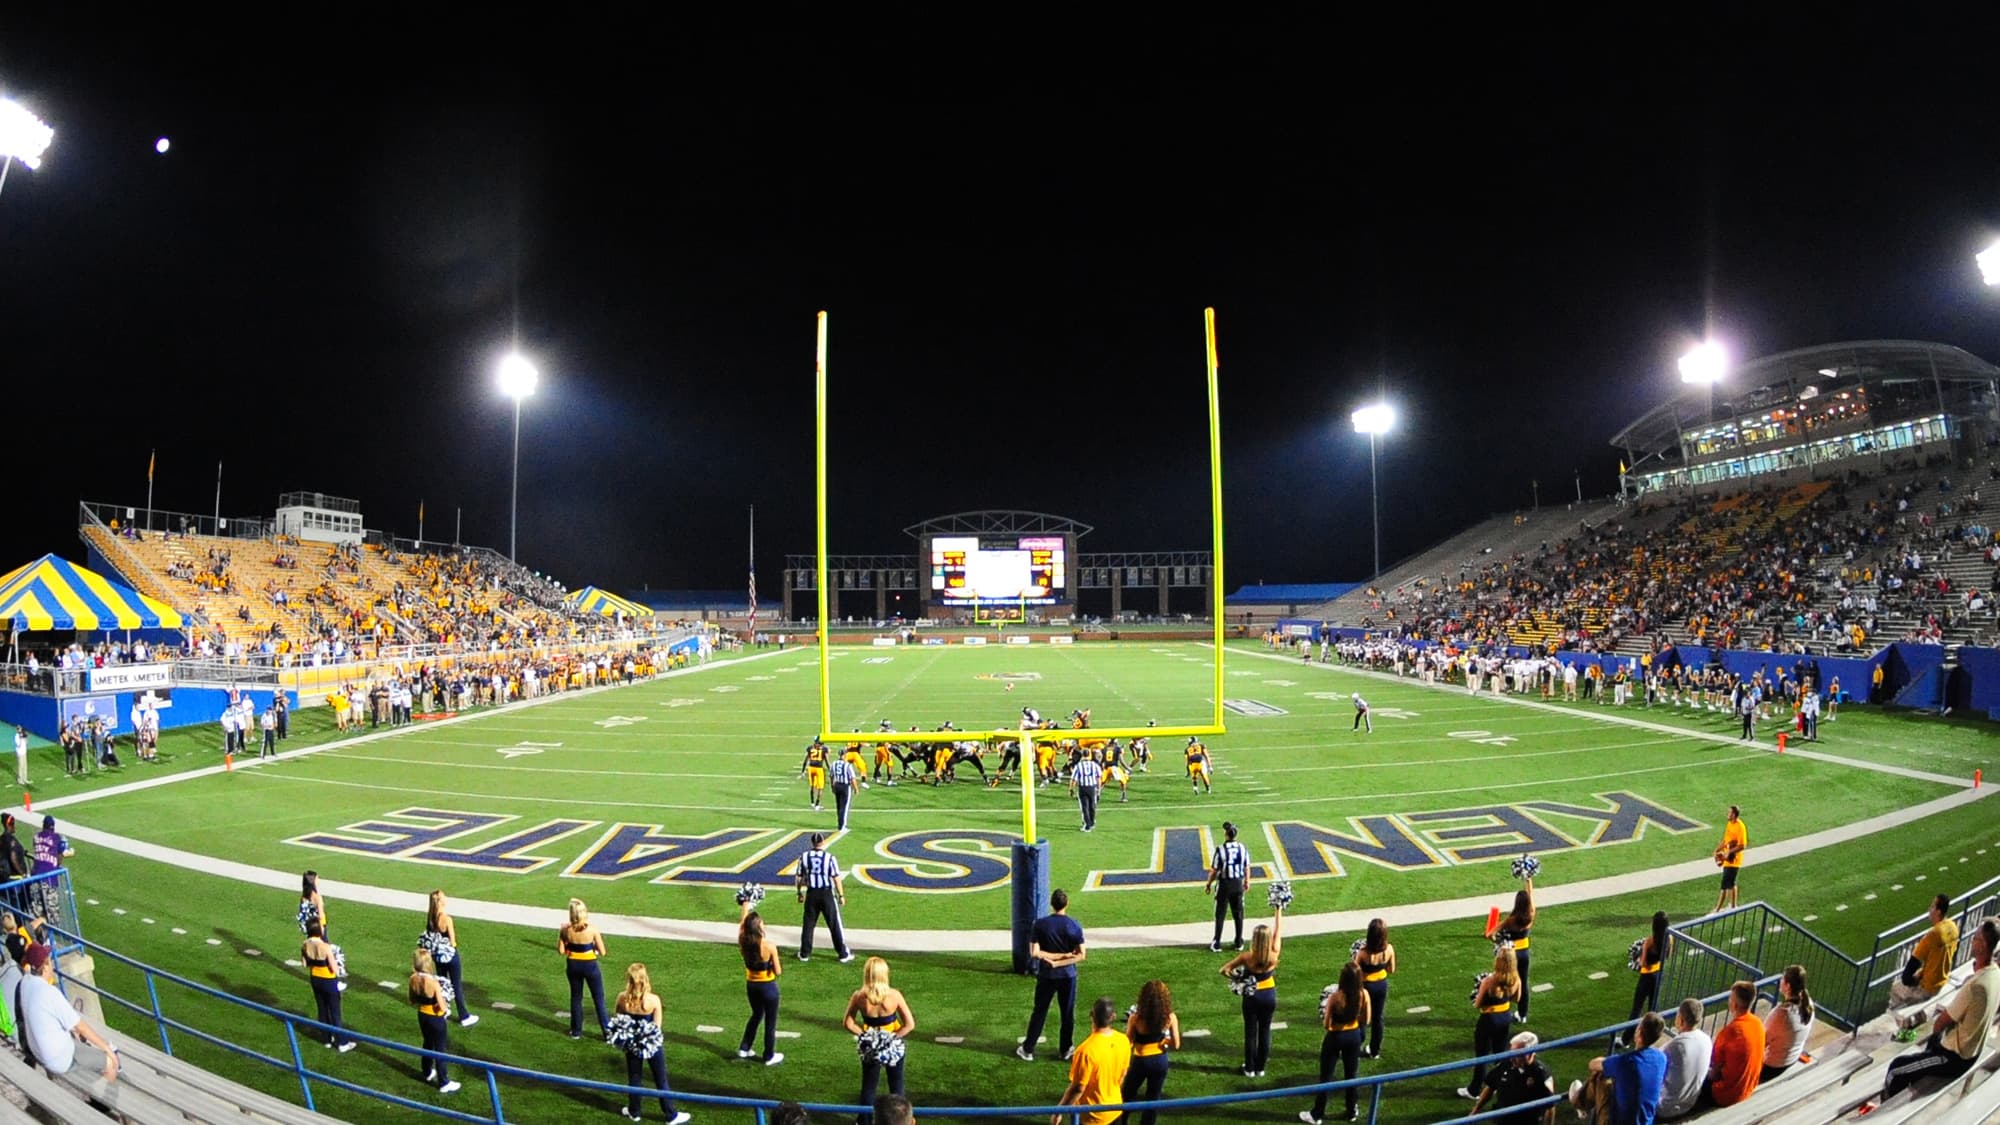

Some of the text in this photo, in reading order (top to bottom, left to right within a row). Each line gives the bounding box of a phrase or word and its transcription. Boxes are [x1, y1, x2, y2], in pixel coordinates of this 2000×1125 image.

[809, 749, 823, 761] 21
[1105, 750, 1113, 761] 8
[835, 764, 843, 775] S
[281, 790, 1712, 895] KENT STATE
[1227, 848, 1239, 864] F
[811, 858, 822, 874] B
